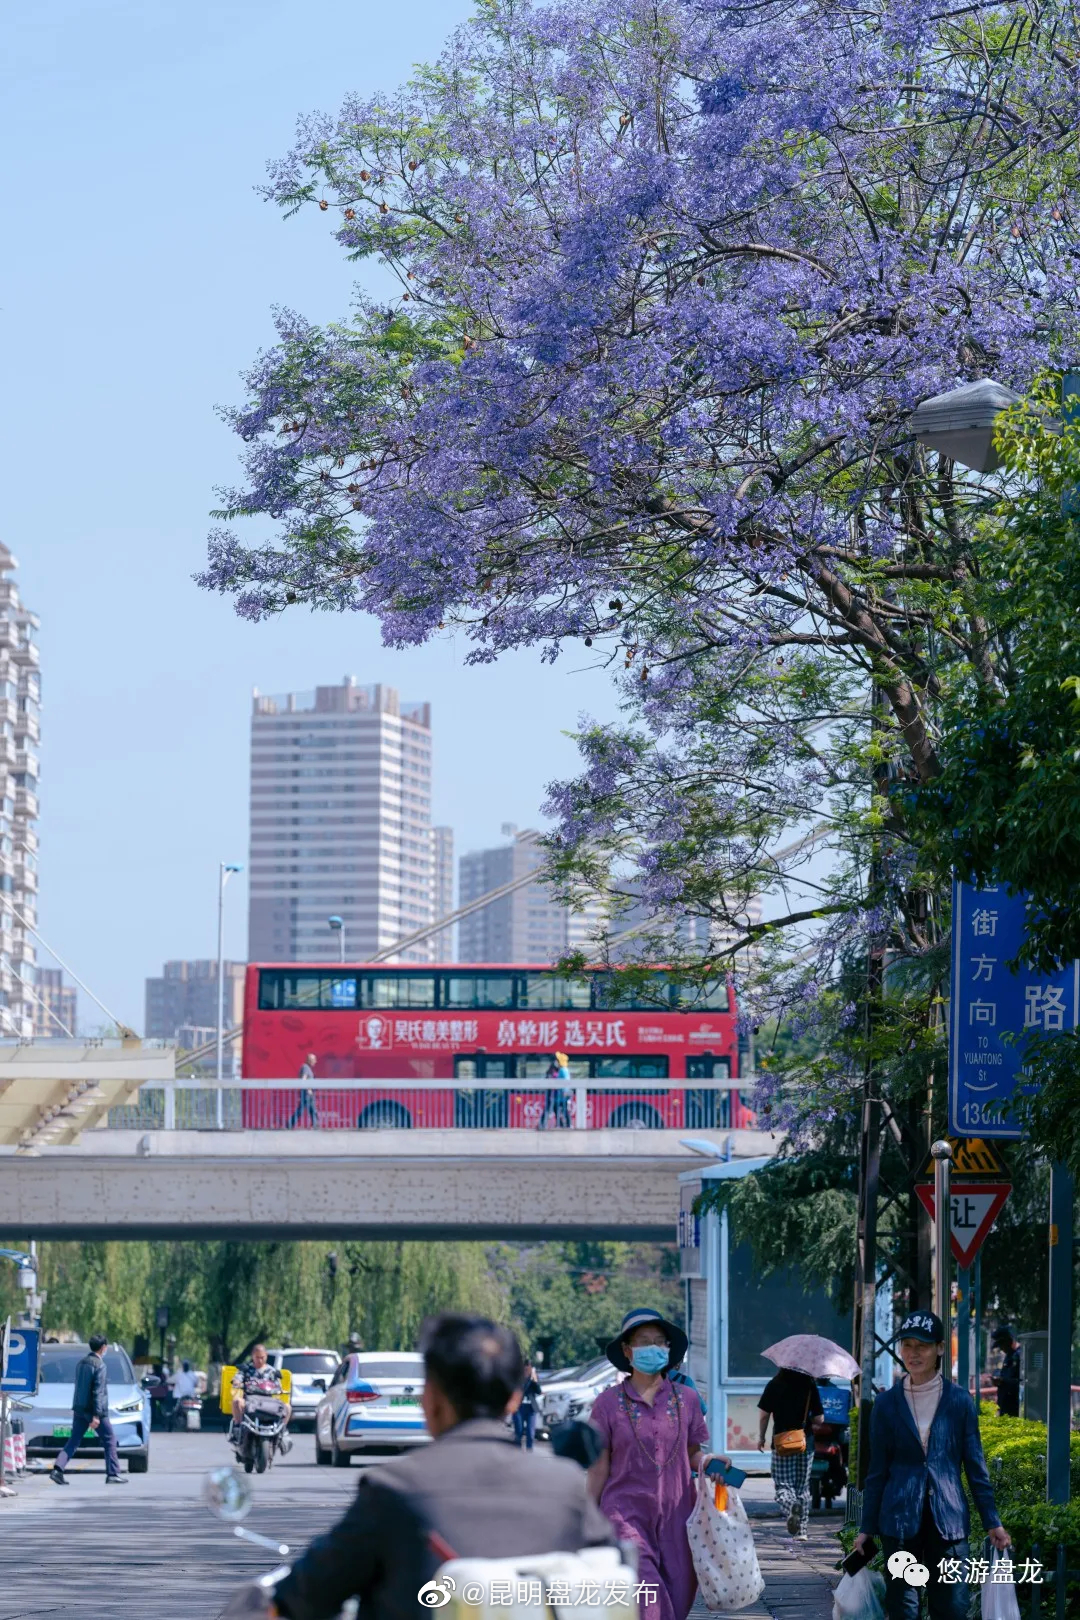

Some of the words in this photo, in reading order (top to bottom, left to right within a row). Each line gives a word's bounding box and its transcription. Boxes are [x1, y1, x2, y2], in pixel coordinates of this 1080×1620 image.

[497, 1019, 559, 1047] 鼻整形
[564, 1019, 626, 1047] 选吴氏
[978, 1036, 989, 1049] TO
[964, 1052, 1003, 1065] YUANTONG
[978, 1069, 987, 1081] St
[950, 1197, 977, 1229] 让
